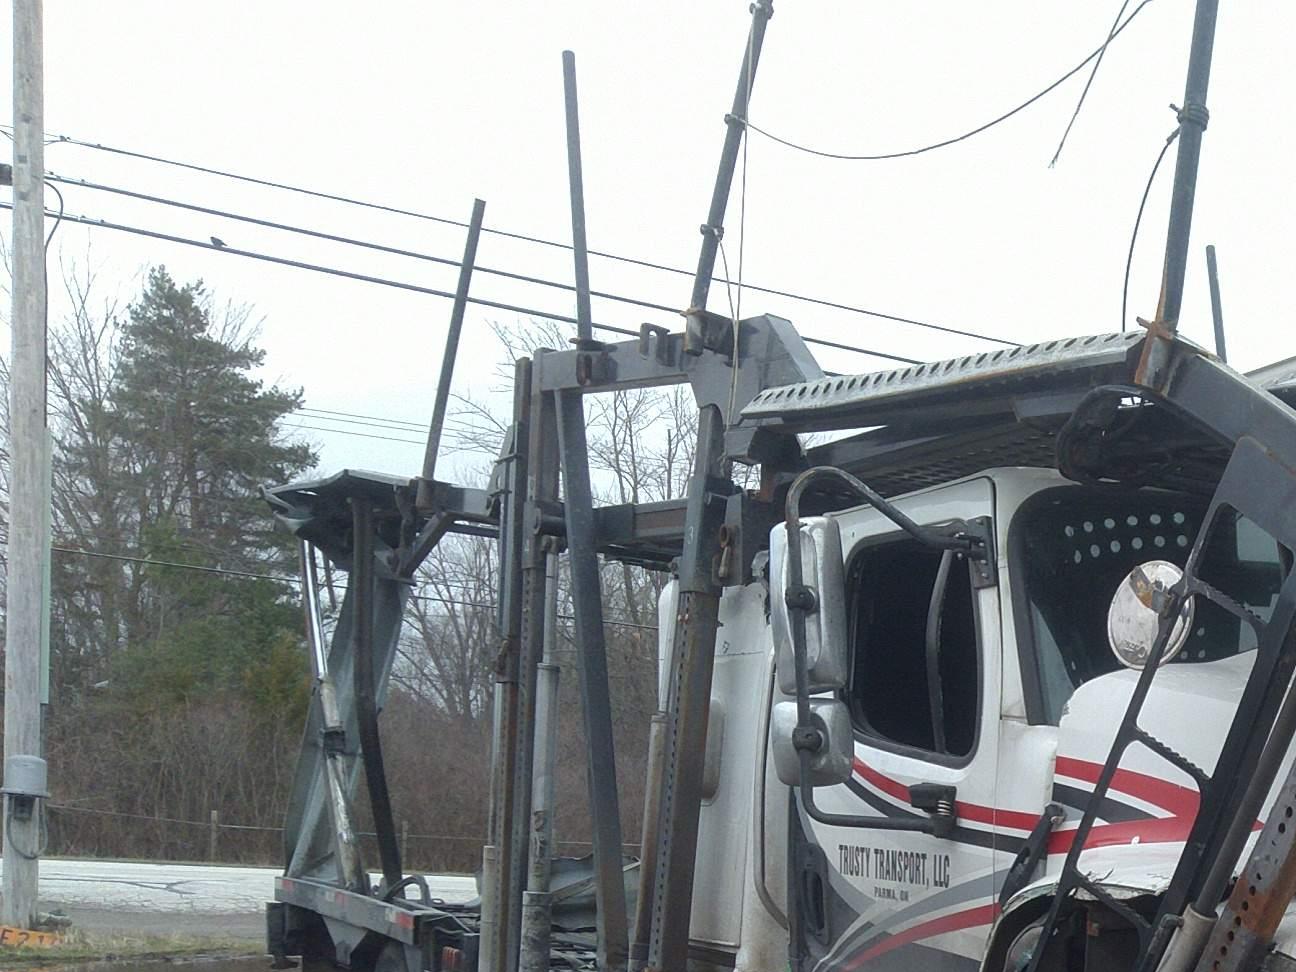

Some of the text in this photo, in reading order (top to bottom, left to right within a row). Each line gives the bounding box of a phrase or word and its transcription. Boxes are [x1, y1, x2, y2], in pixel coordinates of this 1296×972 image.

[838, 844, 950, 890] TRUSTY TRANSPORT, LLC
